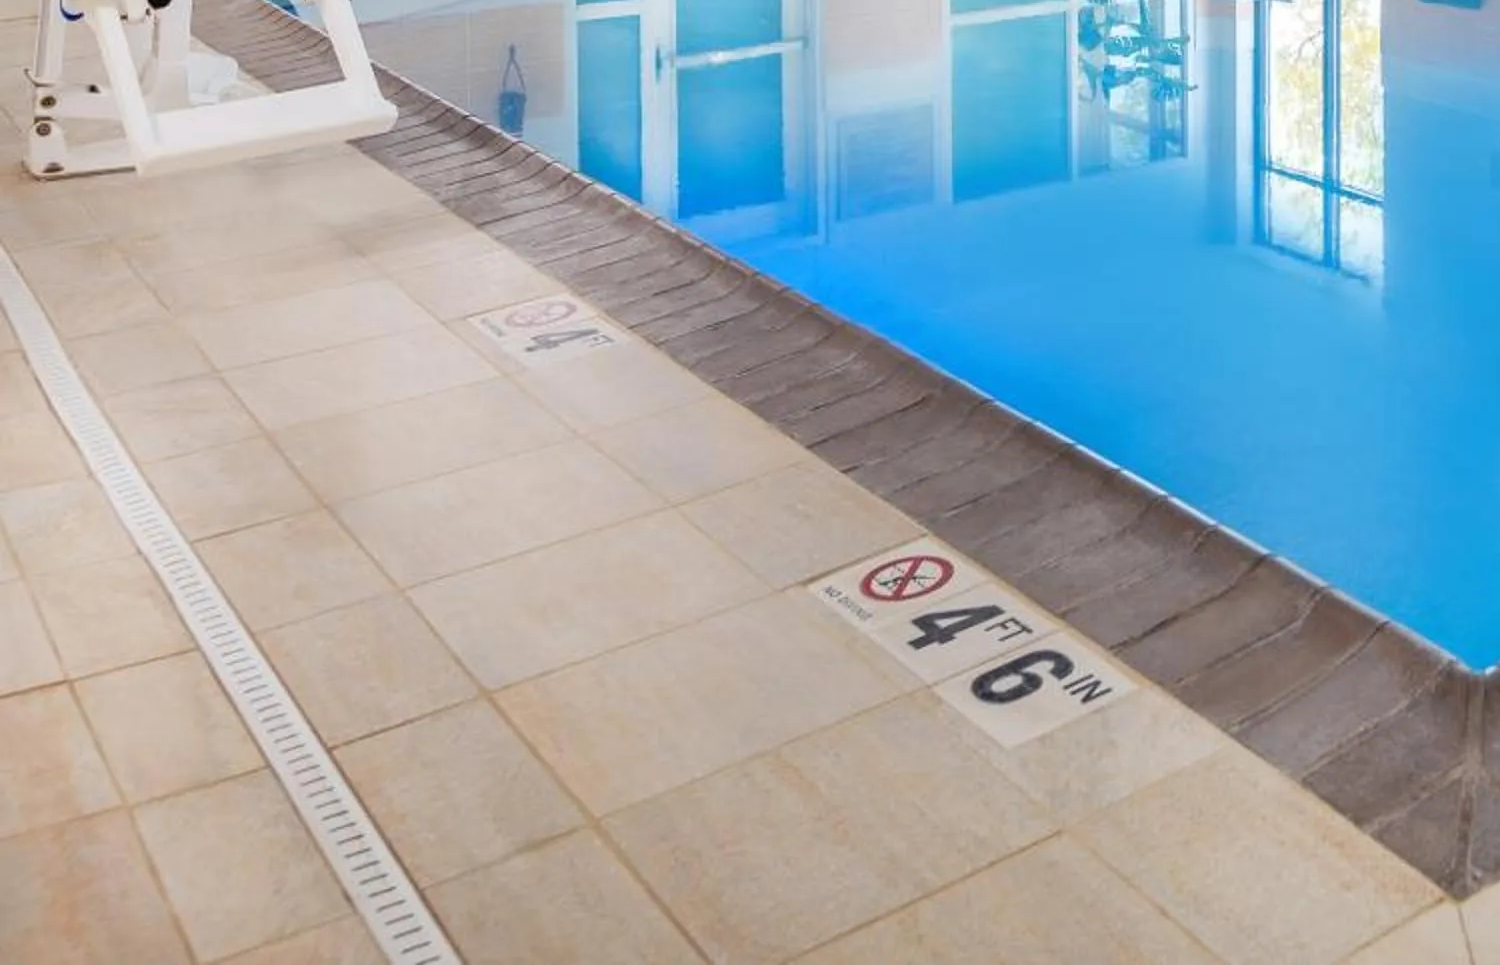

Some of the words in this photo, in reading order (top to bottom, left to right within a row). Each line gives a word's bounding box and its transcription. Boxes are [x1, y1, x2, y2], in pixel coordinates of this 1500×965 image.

[524, 328, 600, 353] 4
[907, 604, 1006, 650] 4
[984, 617, 1034, 643] FT
[971, 649, 1076, 705] 6
[1062, 673, 1113, 705] IN
